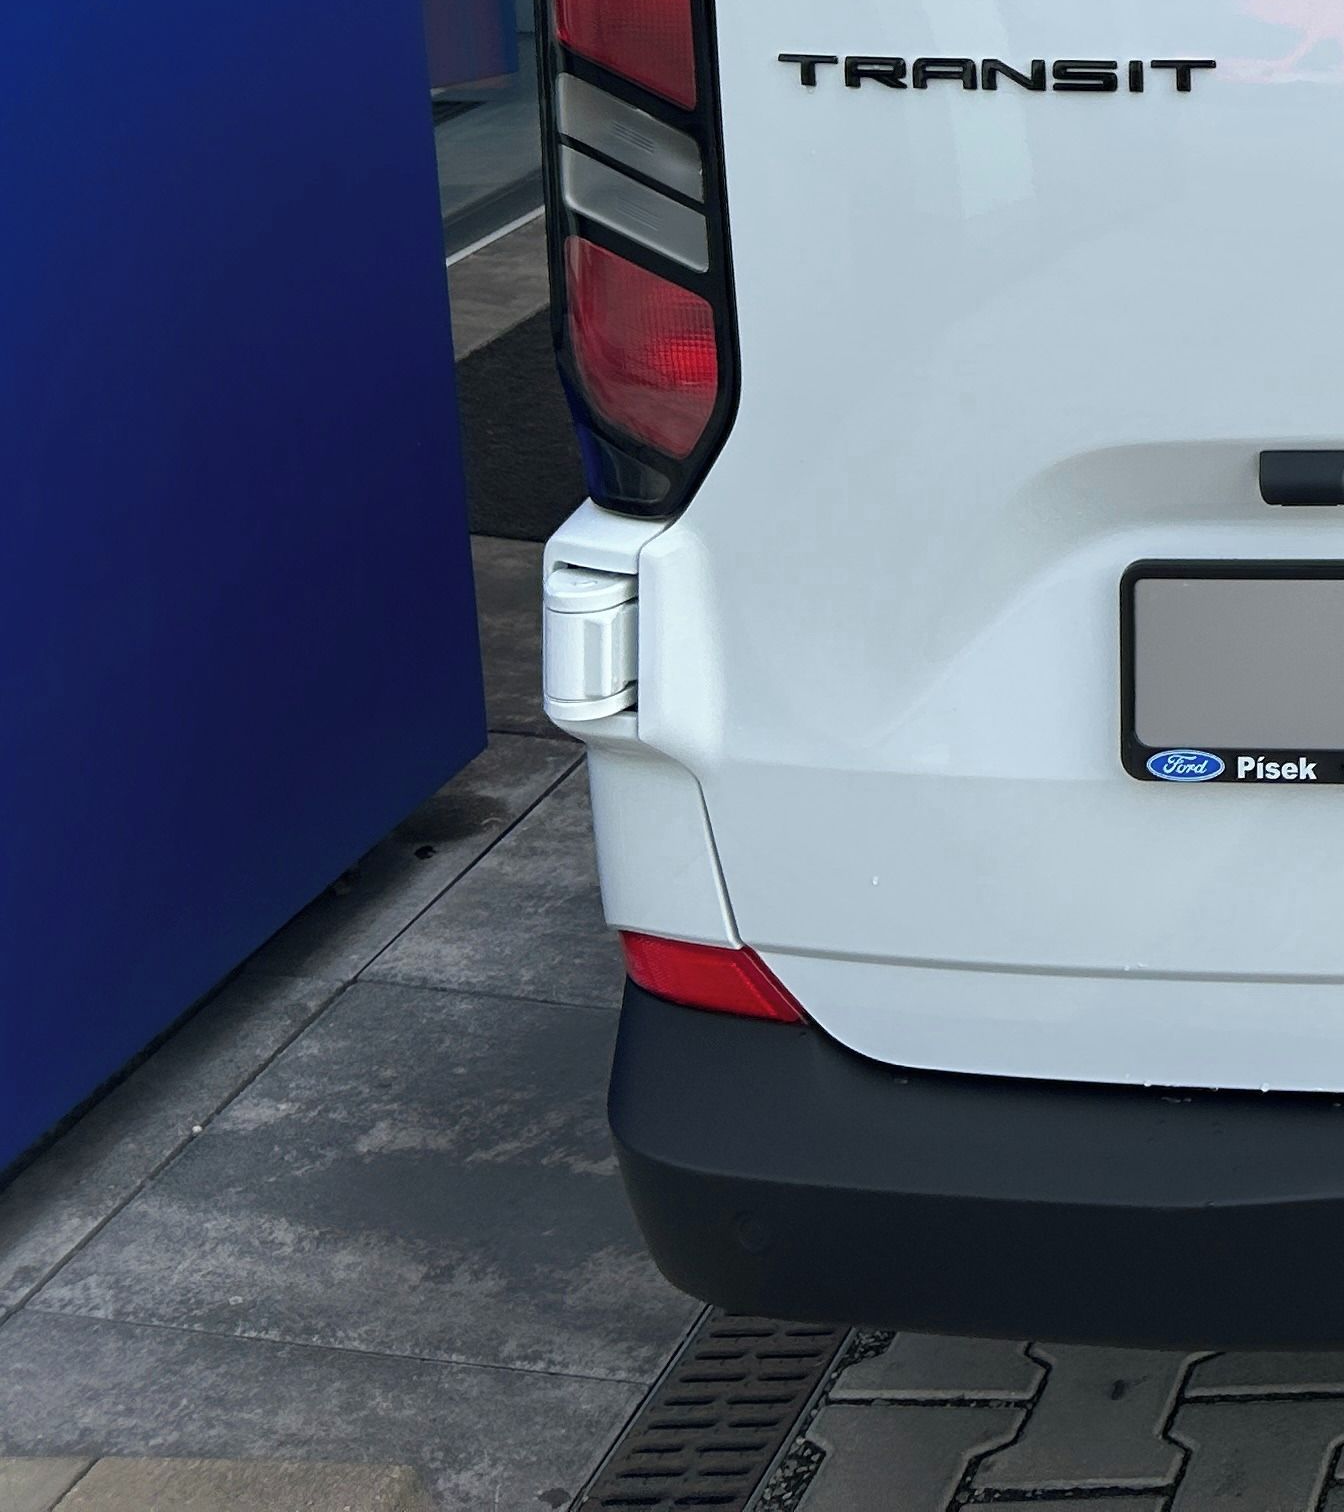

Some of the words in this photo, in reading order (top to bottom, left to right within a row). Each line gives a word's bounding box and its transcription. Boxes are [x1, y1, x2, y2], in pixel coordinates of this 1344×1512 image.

[778, 53, 1217, 93] TRANSIT
[1163, 754, 1209, 774] Ford
[1238, 755, 1317, 779] Písek
